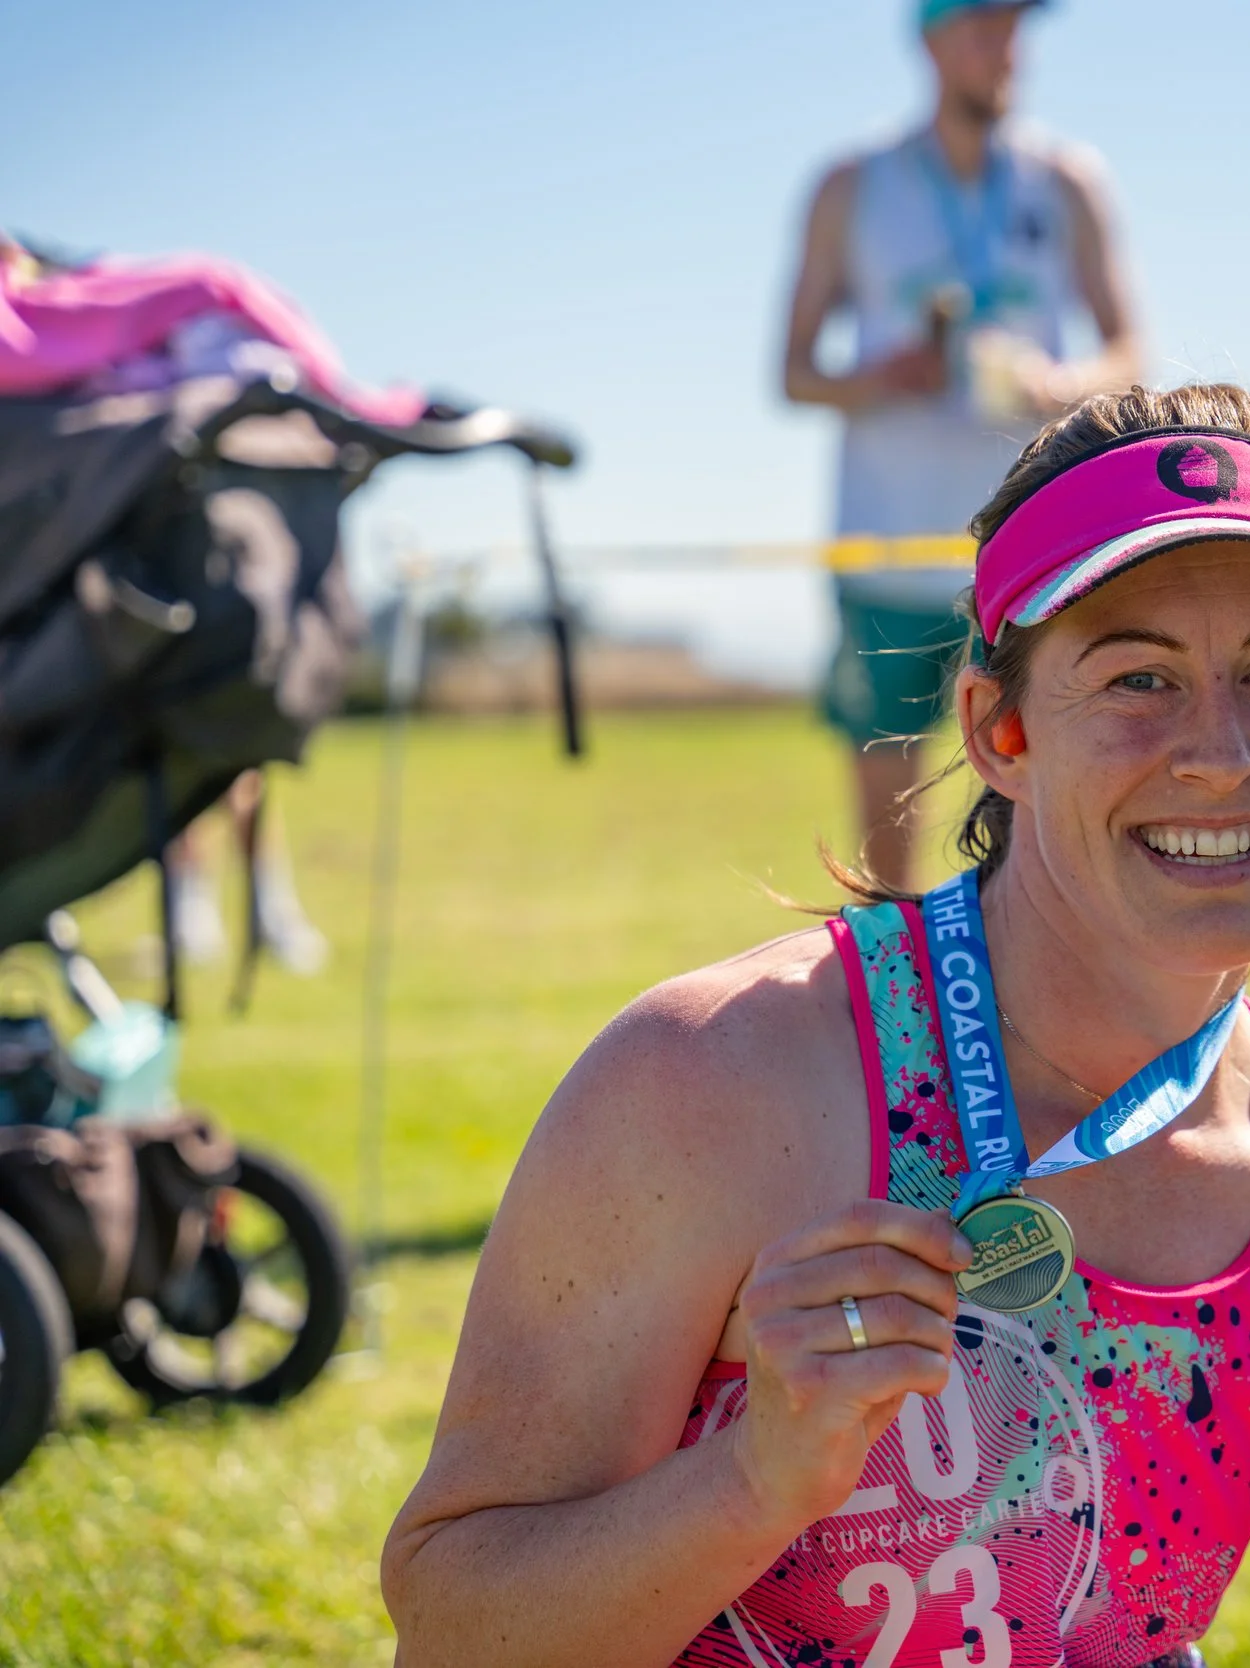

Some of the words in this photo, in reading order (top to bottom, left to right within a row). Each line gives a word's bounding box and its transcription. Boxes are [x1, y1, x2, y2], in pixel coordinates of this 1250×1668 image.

[932, 888, 970, 942] THE
[941, 951, 1002, 1129] COASTAL
[974, 1136, 1016, 1172] RU
[821, 1514, 949, 1554] CUPCAKE
[961, 1491, 1044, 1531] CARTE
[843, 1544, 1012, 1668] 23
